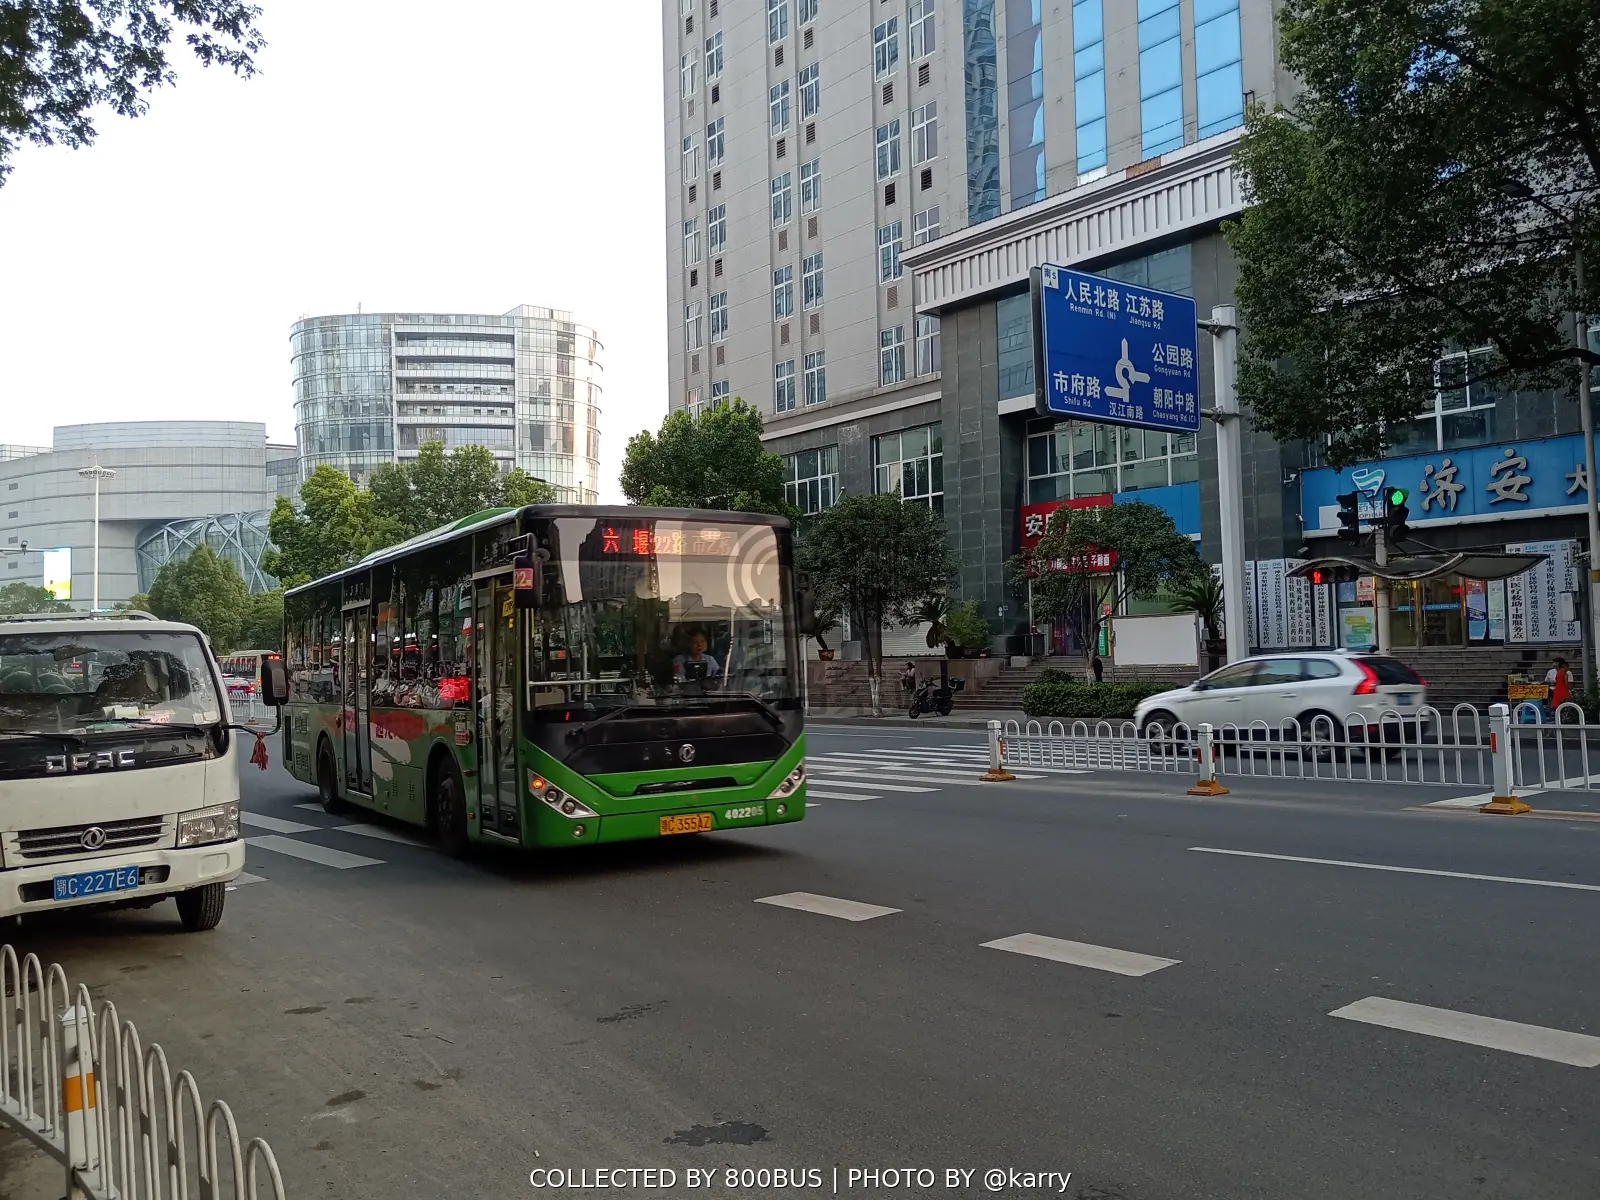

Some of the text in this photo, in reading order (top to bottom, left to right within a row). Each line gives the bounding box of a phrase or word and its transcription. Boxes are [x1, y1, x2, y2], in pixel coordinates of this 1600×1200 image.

[1065, 278, 1164, 321] 人民北路 江苏路
[1069, 303, 1093, 316] Renmin
[1107, 309, 1116, 320] (N)
[1129, 315, 1162, 330] Jiangsu Rd.
[1152, 342, 1194, 370] 公园路
[1154, 364, 1192, 378] Gongyuan Rd.
[1053, 370, 1101, 399] 市府路
[1064, 396, 1092, 408] Shifu Rd.
[1153, 386, 1195, 414] 朝阳中路
[1109, 401, 1144, 420] 汉江南路
[1152, 410, 1179, 422] Chaoyang
[725, 806, 764, 820] 402205
